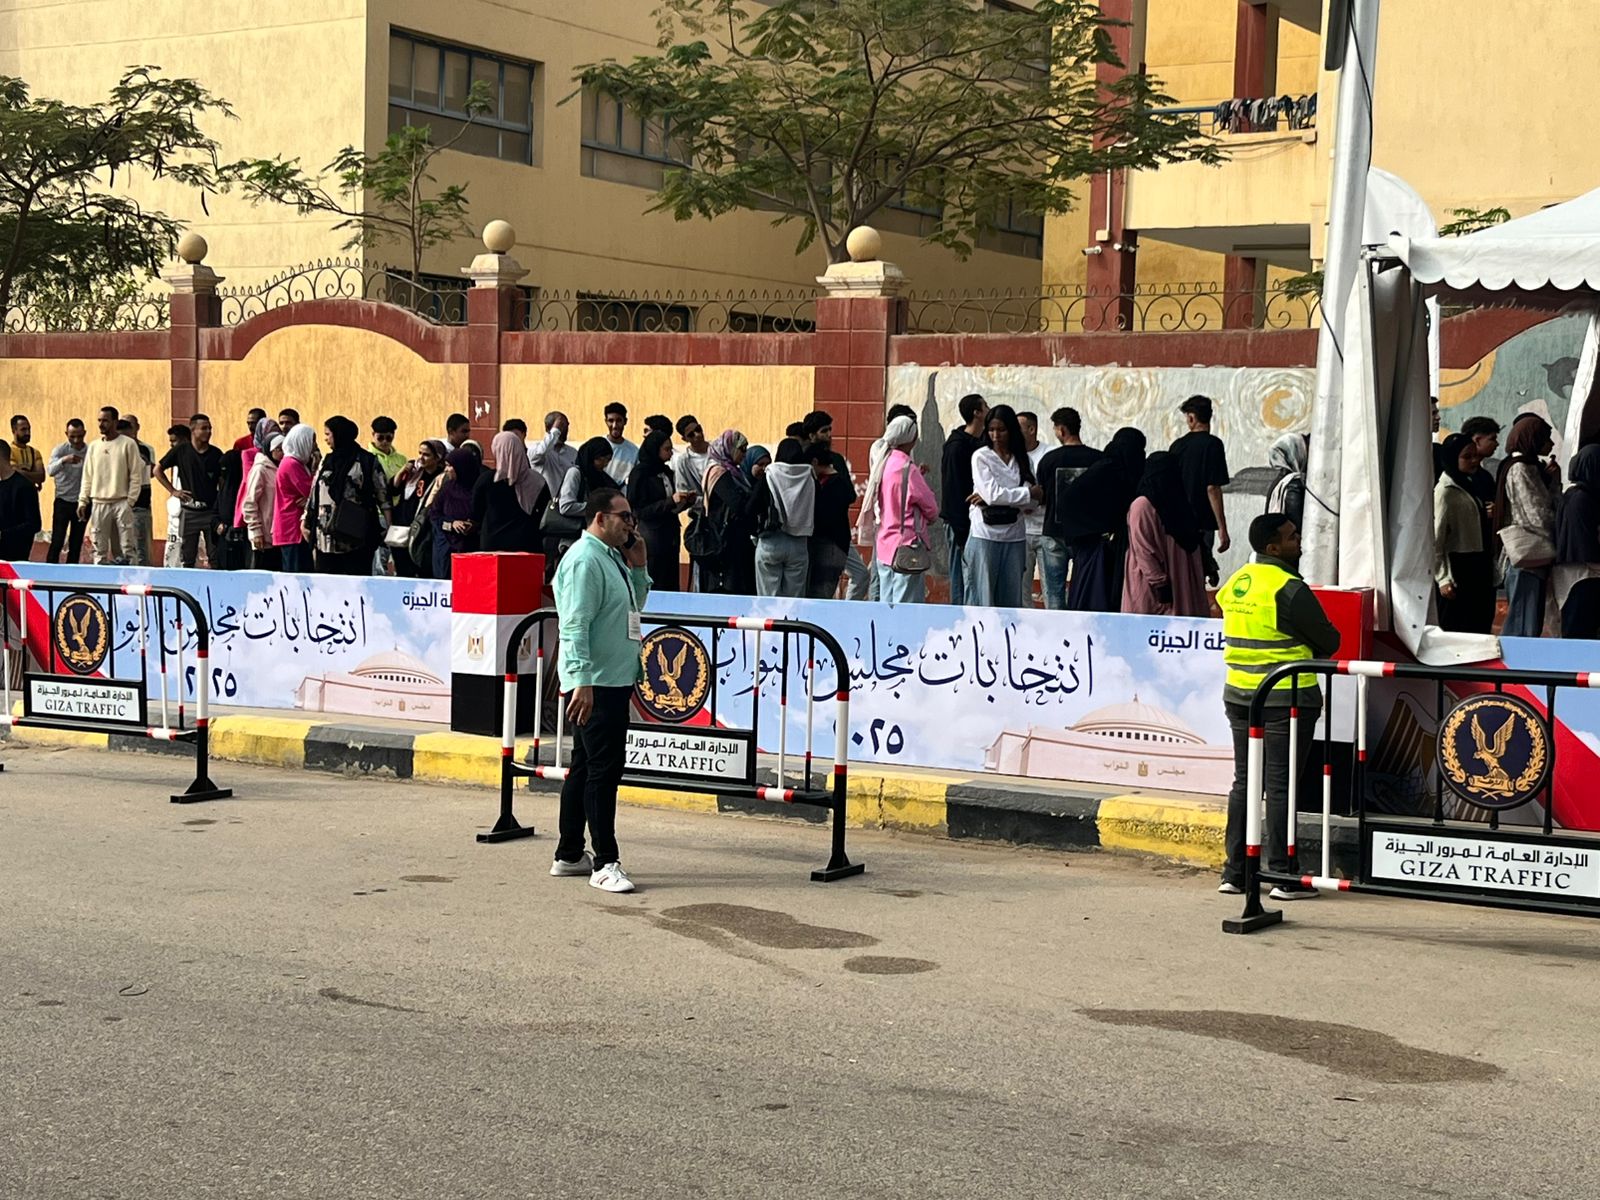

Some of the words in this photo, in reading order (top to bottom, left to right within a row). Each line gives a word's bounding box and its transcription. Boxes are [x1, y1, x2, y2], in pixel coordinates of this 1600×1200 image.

[402, 592, 437, 610] الجيزة
[243, 584, 367, 655] انتخابات
[1148, 629, 1199, 653] الجيزة
[919, 620, 1094, 706] انتخابات
[45, 699, 73, 712] GIZA
[76, 702, 126, 716] TRAFFIC
[630, 751, 651, 766] ZA
[657, 753, 726, 772] TRAFFIC
[1385, 838, 1433, 856] الجيزة
[1437, 845, 1481, 858] لمرور
[1485, 846, 1540, 863] العامة
[1543, 852, 1588, 869] الإدارة
[1400, 859, 1460, 880] GIZA
[1469, 865, 1570, 889] TRAFFIC
